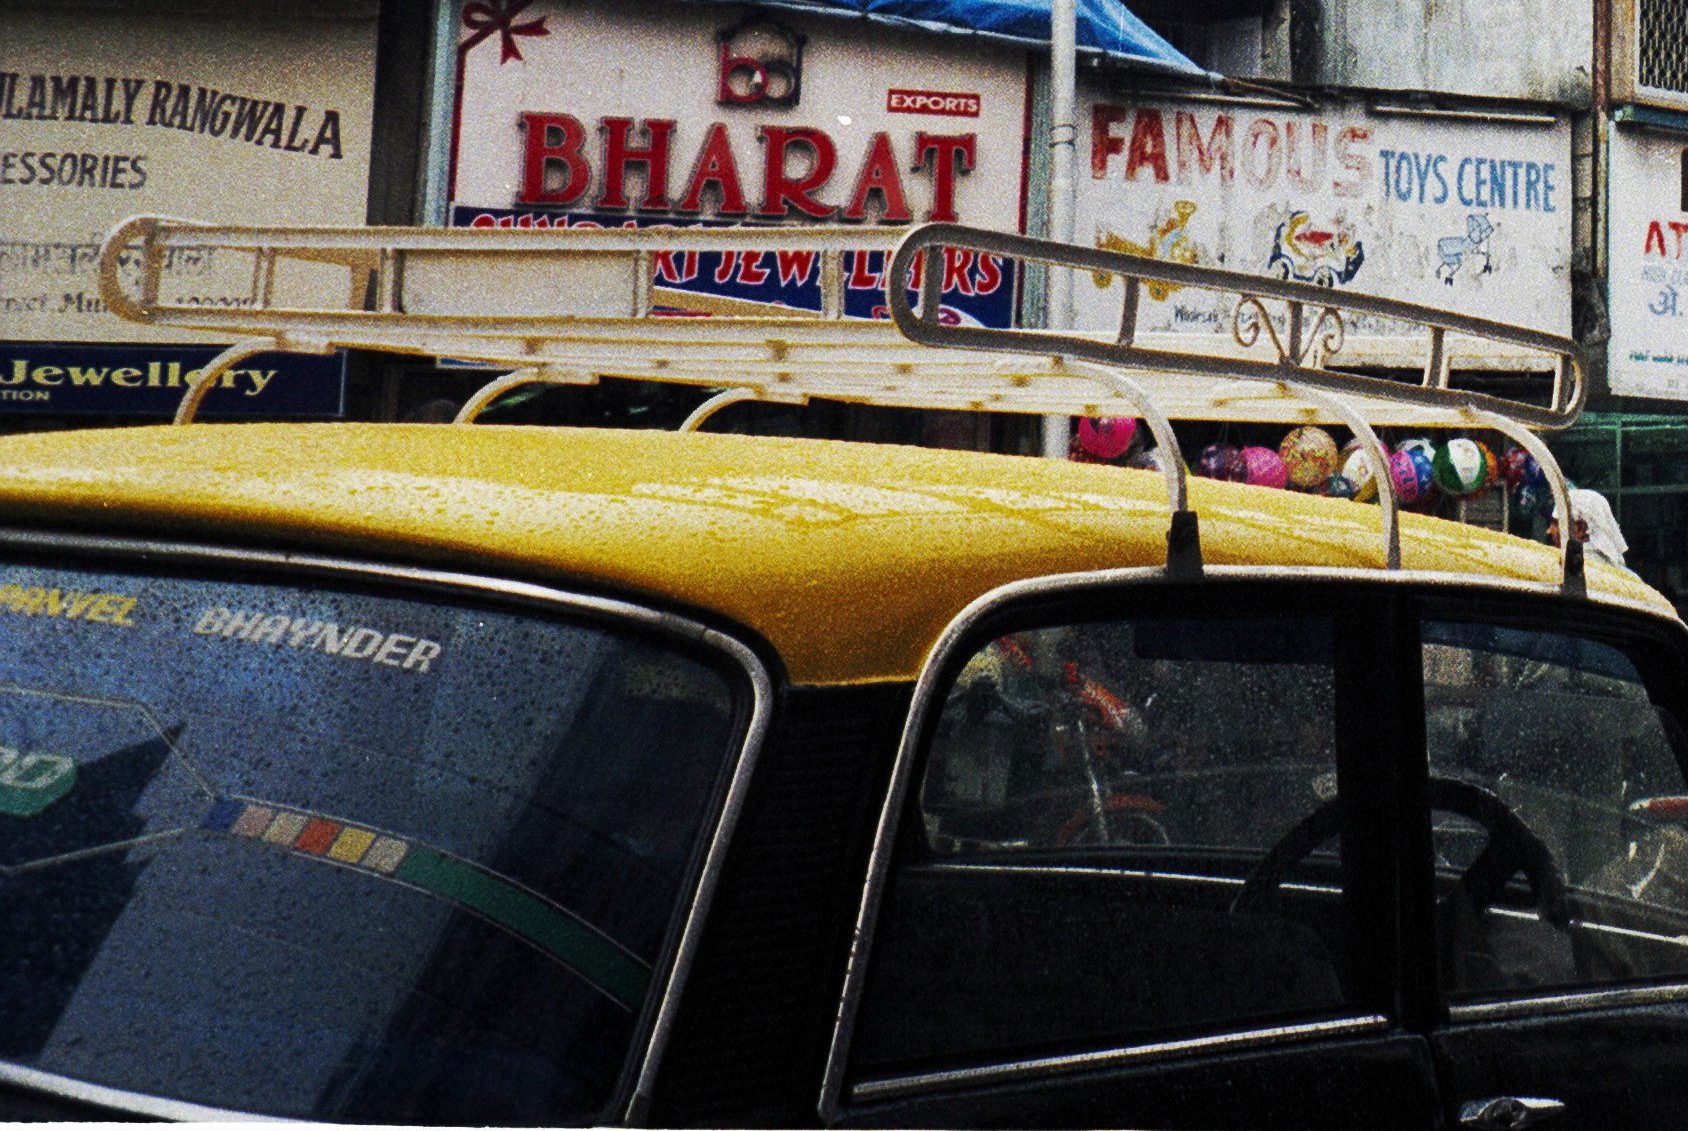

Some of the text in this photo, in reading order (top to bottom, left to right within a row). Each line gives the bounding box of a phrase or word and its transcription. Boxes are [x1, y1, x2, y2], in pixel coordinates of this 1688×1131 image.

[146, 79, 343, 159] RANGWALA
[891, 94, 977, 113] EXPORTS
[516, 110, 977, 223] BHARAT
[1090, 103, 1374, 198] FAMOUS
[1379, 149, 1557, 213] TOYS CENTRE
[194, 606, 442, 673] BHAYNDER
